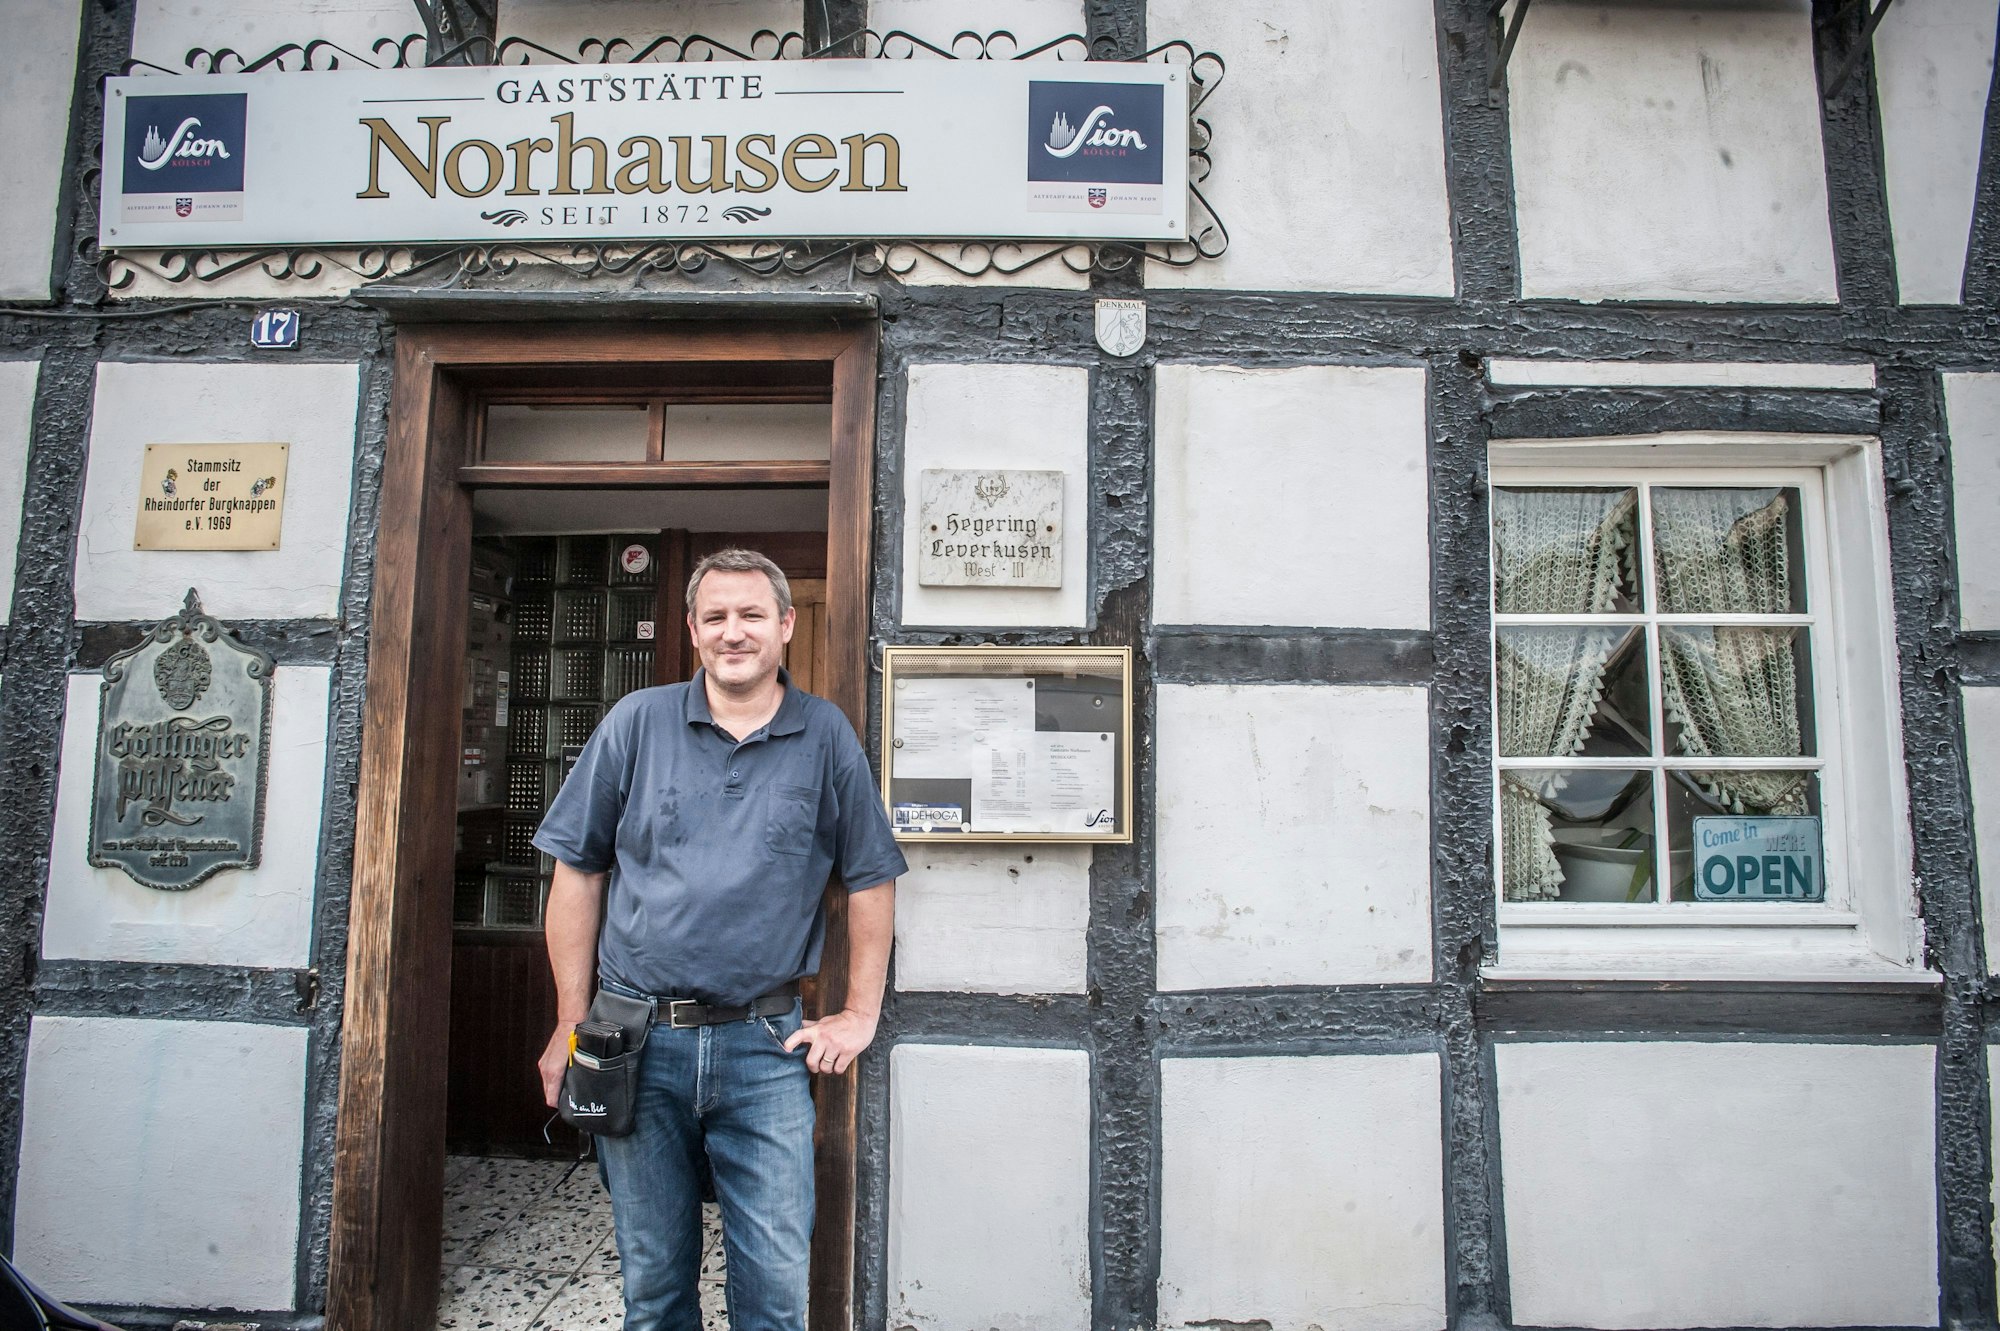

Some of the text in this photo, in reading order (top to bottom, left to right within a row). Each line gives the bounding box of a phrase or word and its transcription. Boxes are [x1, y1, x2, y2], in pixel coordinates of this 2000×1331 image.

[497, 73, 763, 104] GASTSTÄTTE
[1044, 105, 1147, 159] Sion
[138, 117, 231, 170] Sion
[356, 112, 907, 199] Norhausen
[541, 205, 710, 226] SEIT 1872
[1100, 301, 1142, 309] DENKMAL
[258, 311, 291, 343] 17
[187, 458, 241, 473] Stammsitz
[203, 478, 221, 491] der
[145, 497, 276, 514] Rheindorfer Burgknappen
[186, 516, 231, 531] e.V. 1969
[947, 513, 1037, 537] Hegering
[931, 539, 1051, 558] Leverkusen
[964, 562, 996, 577] West
[911, 810, 958, 820] DEHOGA
[1084, 809, 1117, 827] Sion
[1703, 822, 1757, 848] Come in
[1702, 854, 1812, 895] OPEN
